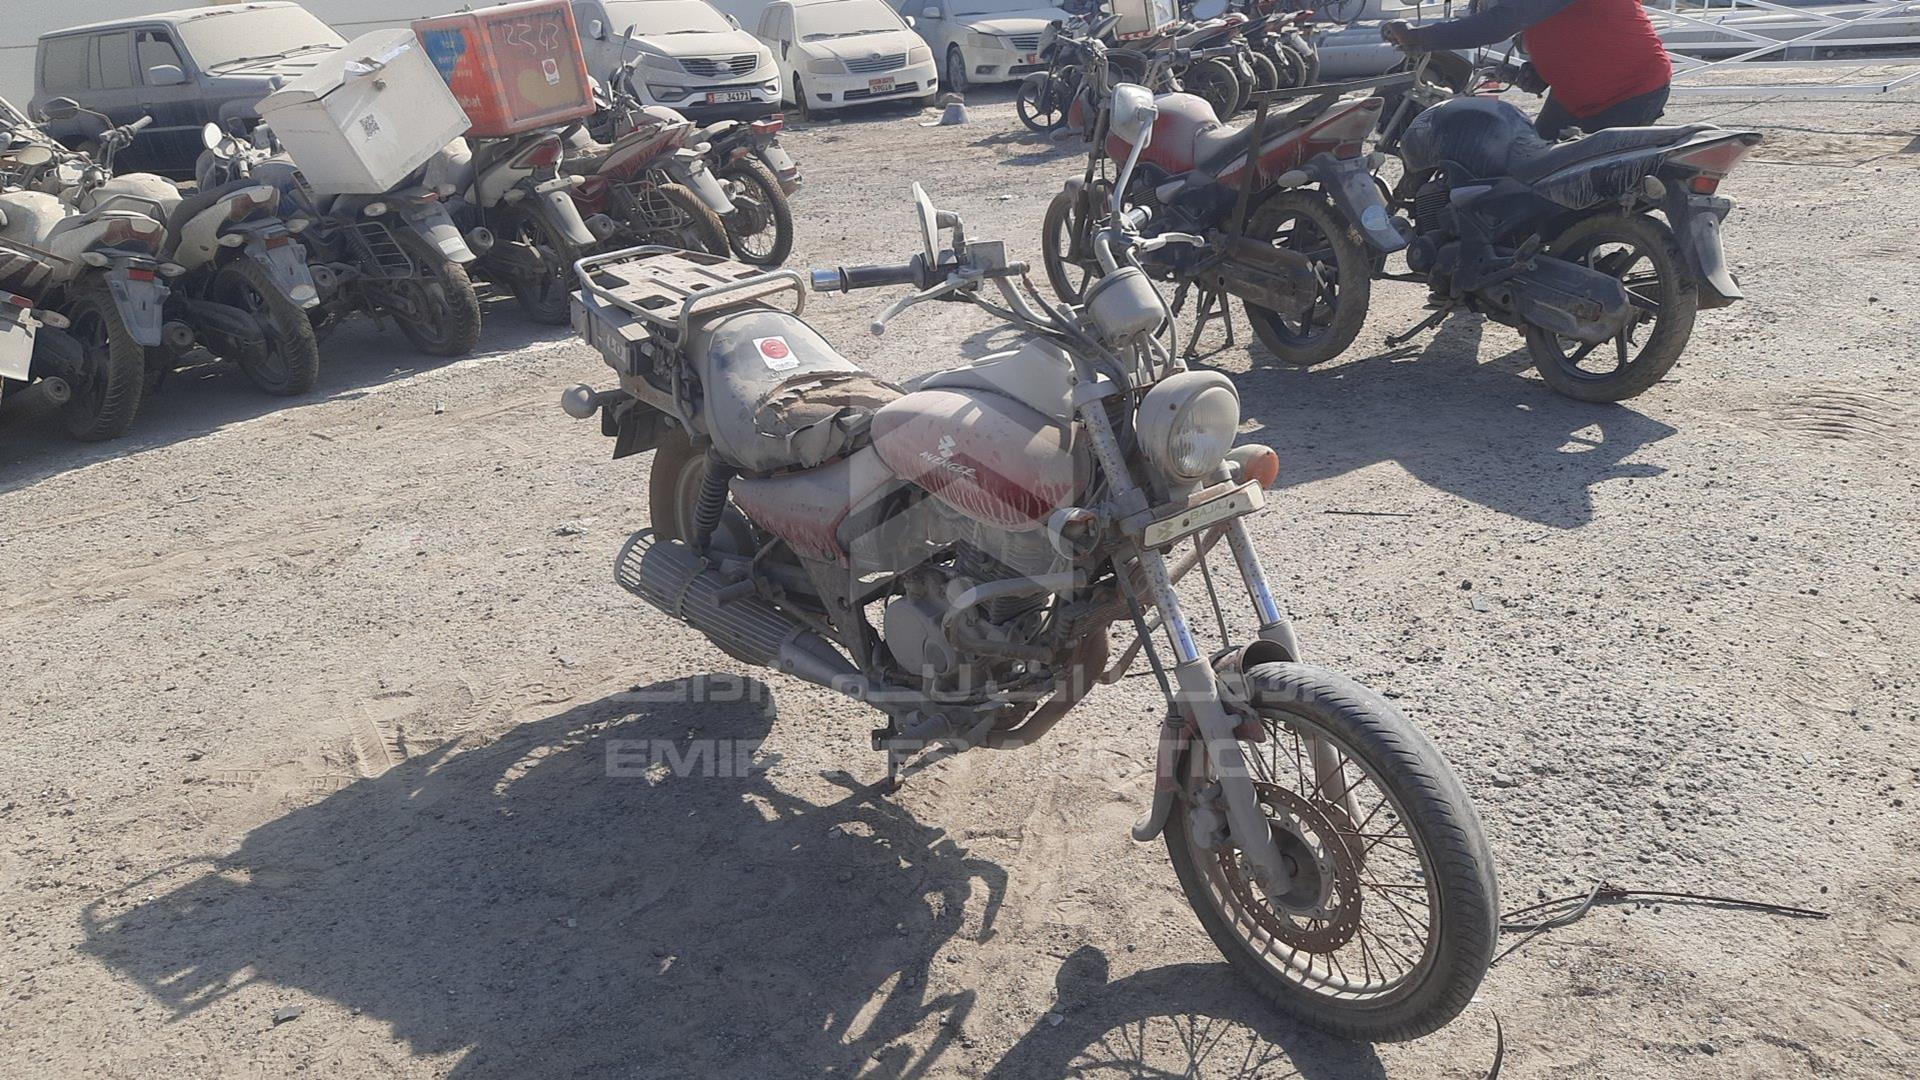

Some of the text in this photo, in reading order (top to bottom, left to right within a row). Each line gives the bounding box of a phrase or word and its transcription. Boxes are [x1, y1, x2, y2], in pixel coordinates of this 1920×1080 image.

[727, 91, 750, 102] 34171
[919, 451, 977, 480] AVENGER
[1189, 499, 1230, 521] BAJAJ
